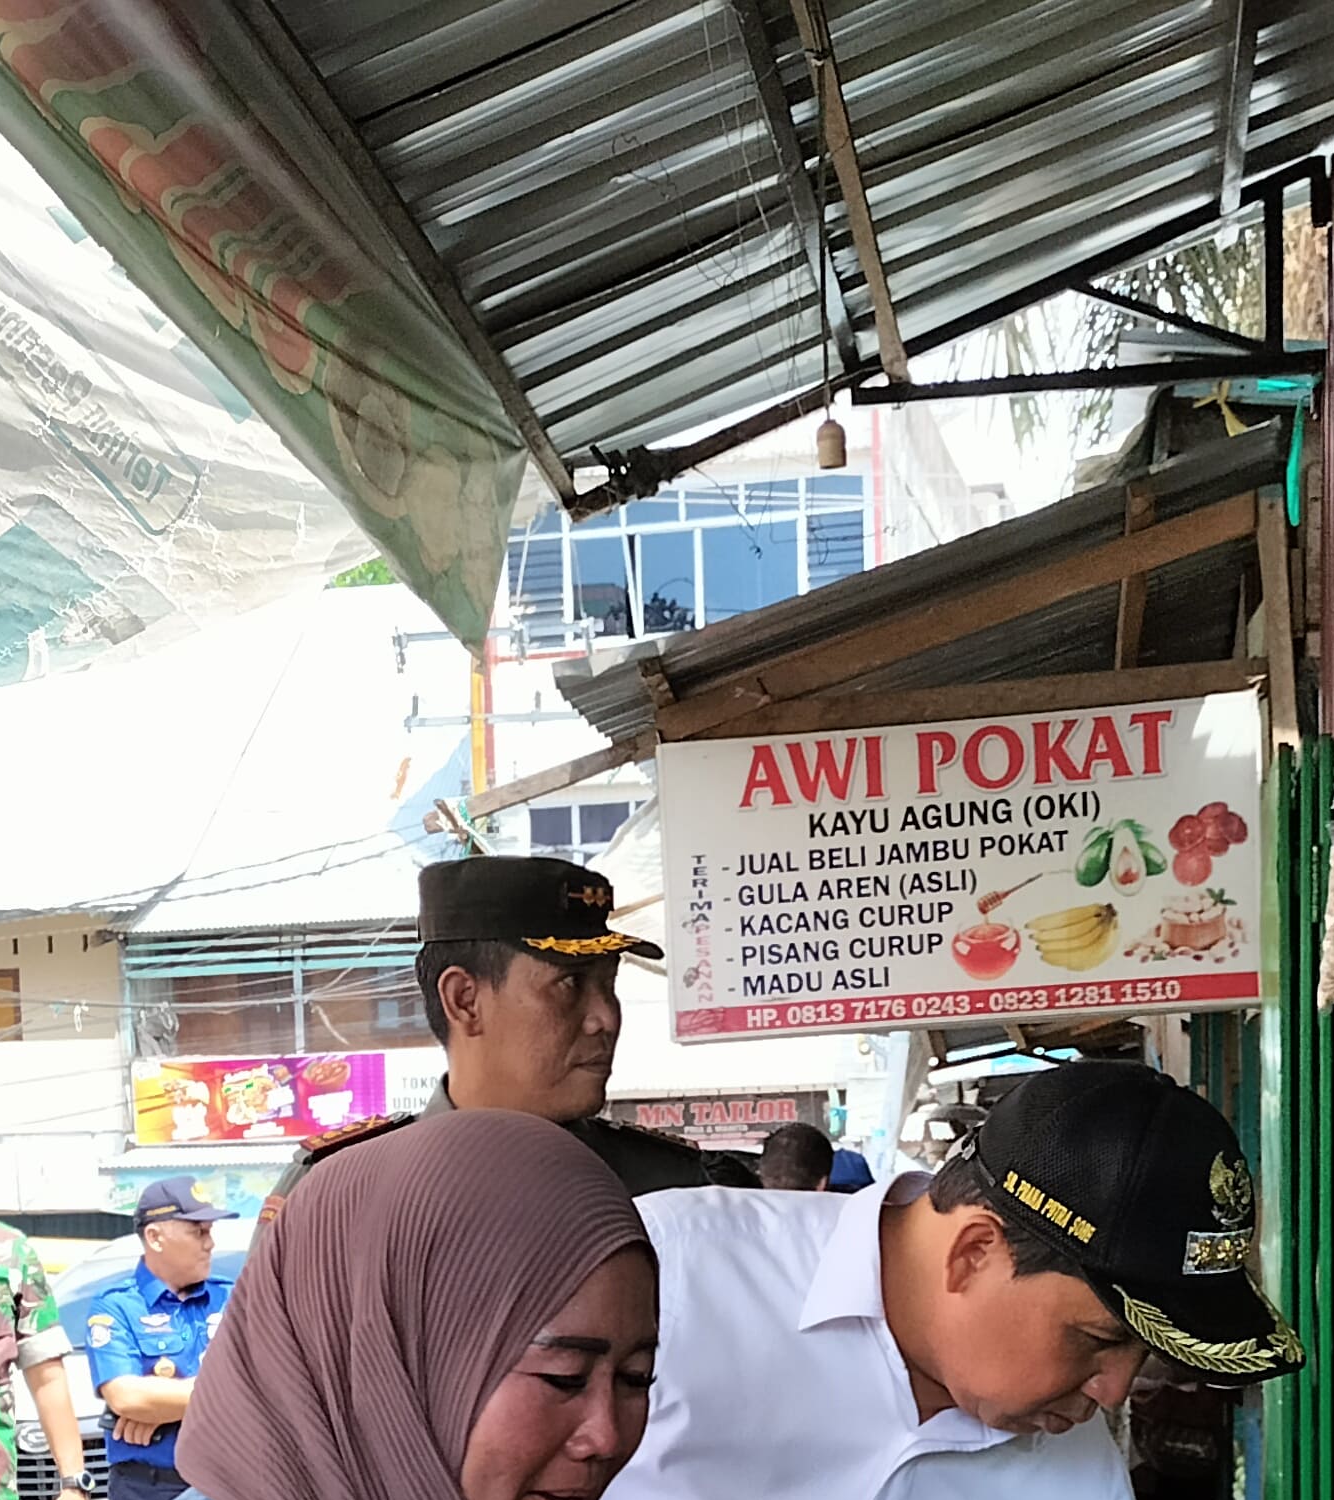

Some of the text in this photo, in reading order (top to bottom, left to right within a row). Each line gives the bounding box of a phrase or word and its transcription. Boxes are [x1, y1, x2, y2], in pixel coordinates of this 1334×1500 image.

[739, 710, 1173, 807] AWI POKAT
[809, 791, 1101, 838] KAYU AGUNG (OKI)
[736, 830, 1069, 876] JUAL BELI JAMBU POKAT
[738, 869, 977, 906] GULA AREN (ASLI)
[740, 902, 954, 937] KACANG CURUP
[741, 933, 943, 967] PISANG CURUP
[743, 966, 890, 997] MADU ASLI
[747, 1008, 781, 1028] HP.
[787, 1003, 844, 1024] 0813
[850, 999, 907, 1021] 7176
[912, 995, 971, 1017] 0243
[989, 989, 1048, 1012] 0823
[1055, 985, 1115, 1007] 1281
[1120, 980, 1181, 1002] 1510
[690, 1099, 798, 1126] TAILOR
